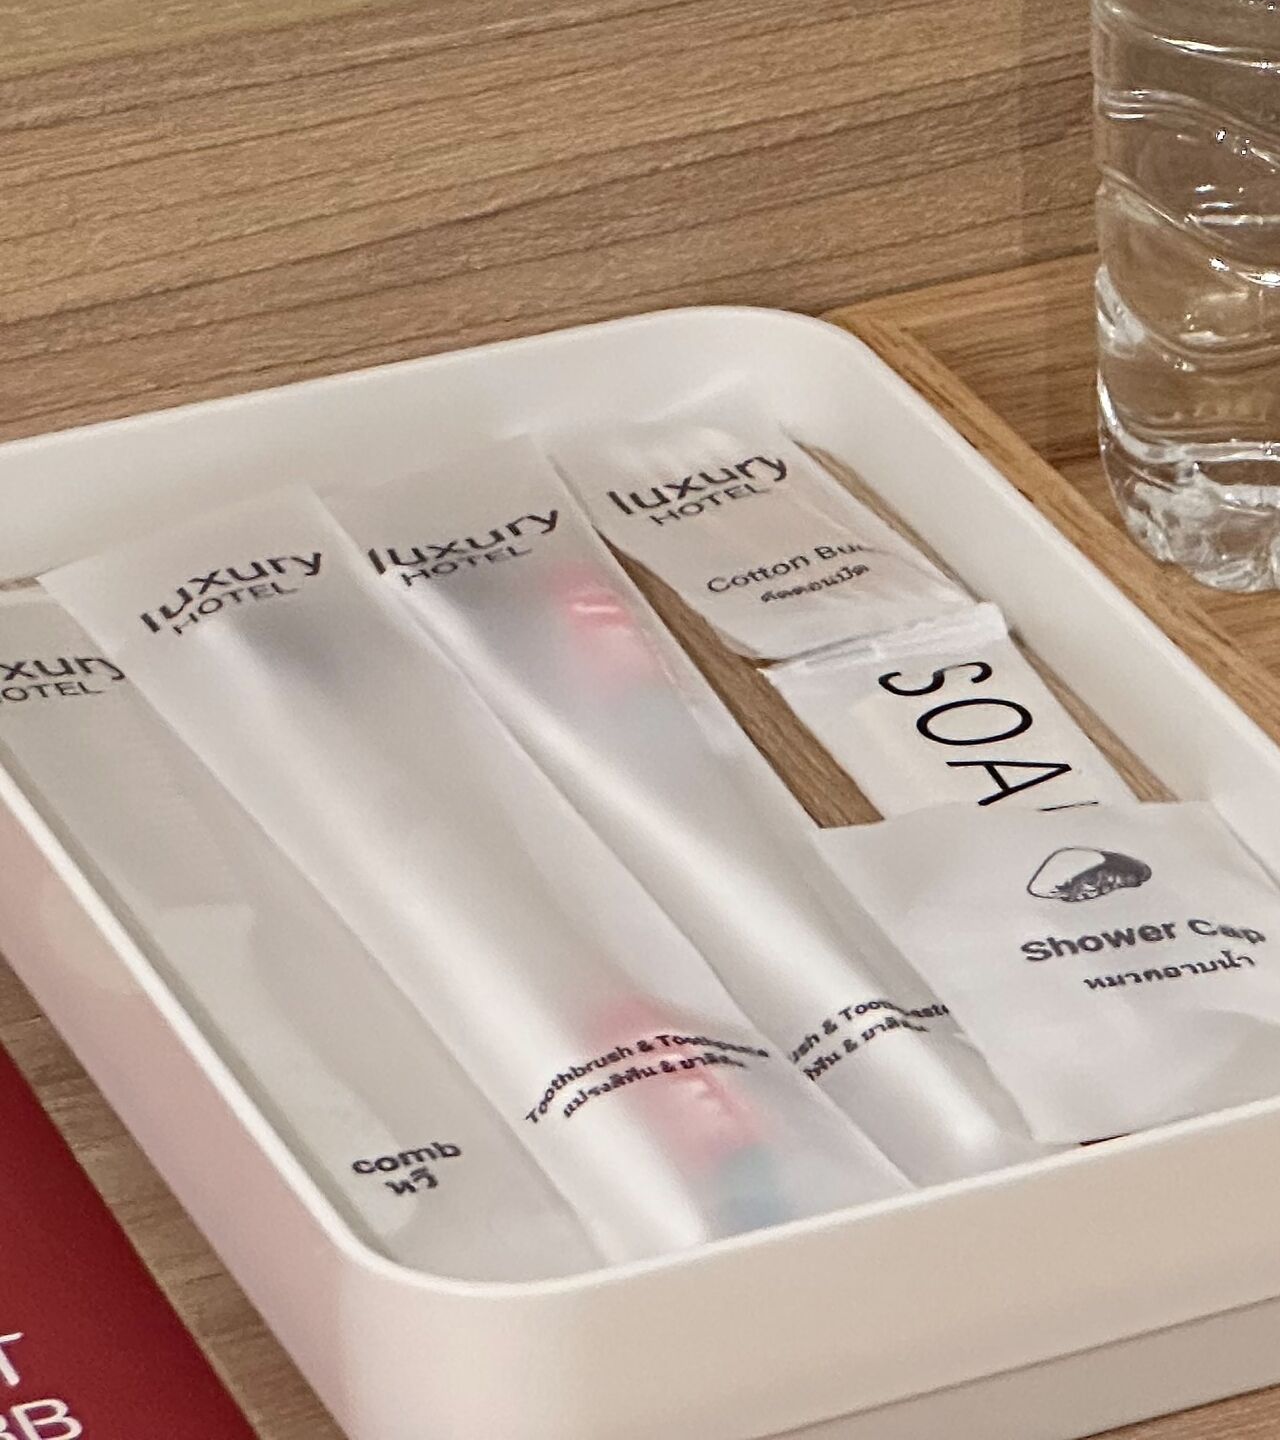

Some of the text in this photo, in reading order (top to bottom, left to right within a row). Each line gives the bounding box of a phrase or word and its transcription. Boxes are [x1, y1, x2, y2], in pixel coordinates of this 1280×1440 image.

[606, 456, 787, 515] luxury
[649, 483, 772, 526] HOTEL
[368, 510, 559, 575] luxury
[401, 546, 532, 587] HOTEL
[706, 554, 811, 594] Cotton
[141, 552, 322, 633] luxury
[173, 582, 298, 635] HOTEL
[0, 658, 125, 681] xury
[0, 681, 105, 702] OTEL
[878, 660, 1098, 812] SOA
[1021, 920, 1176, 962] Shower
[525, 1046, 634, 1124] Toothbrush
[637, 1040, 654, 1053] &
[352, 1142, 462, 1174] comb
